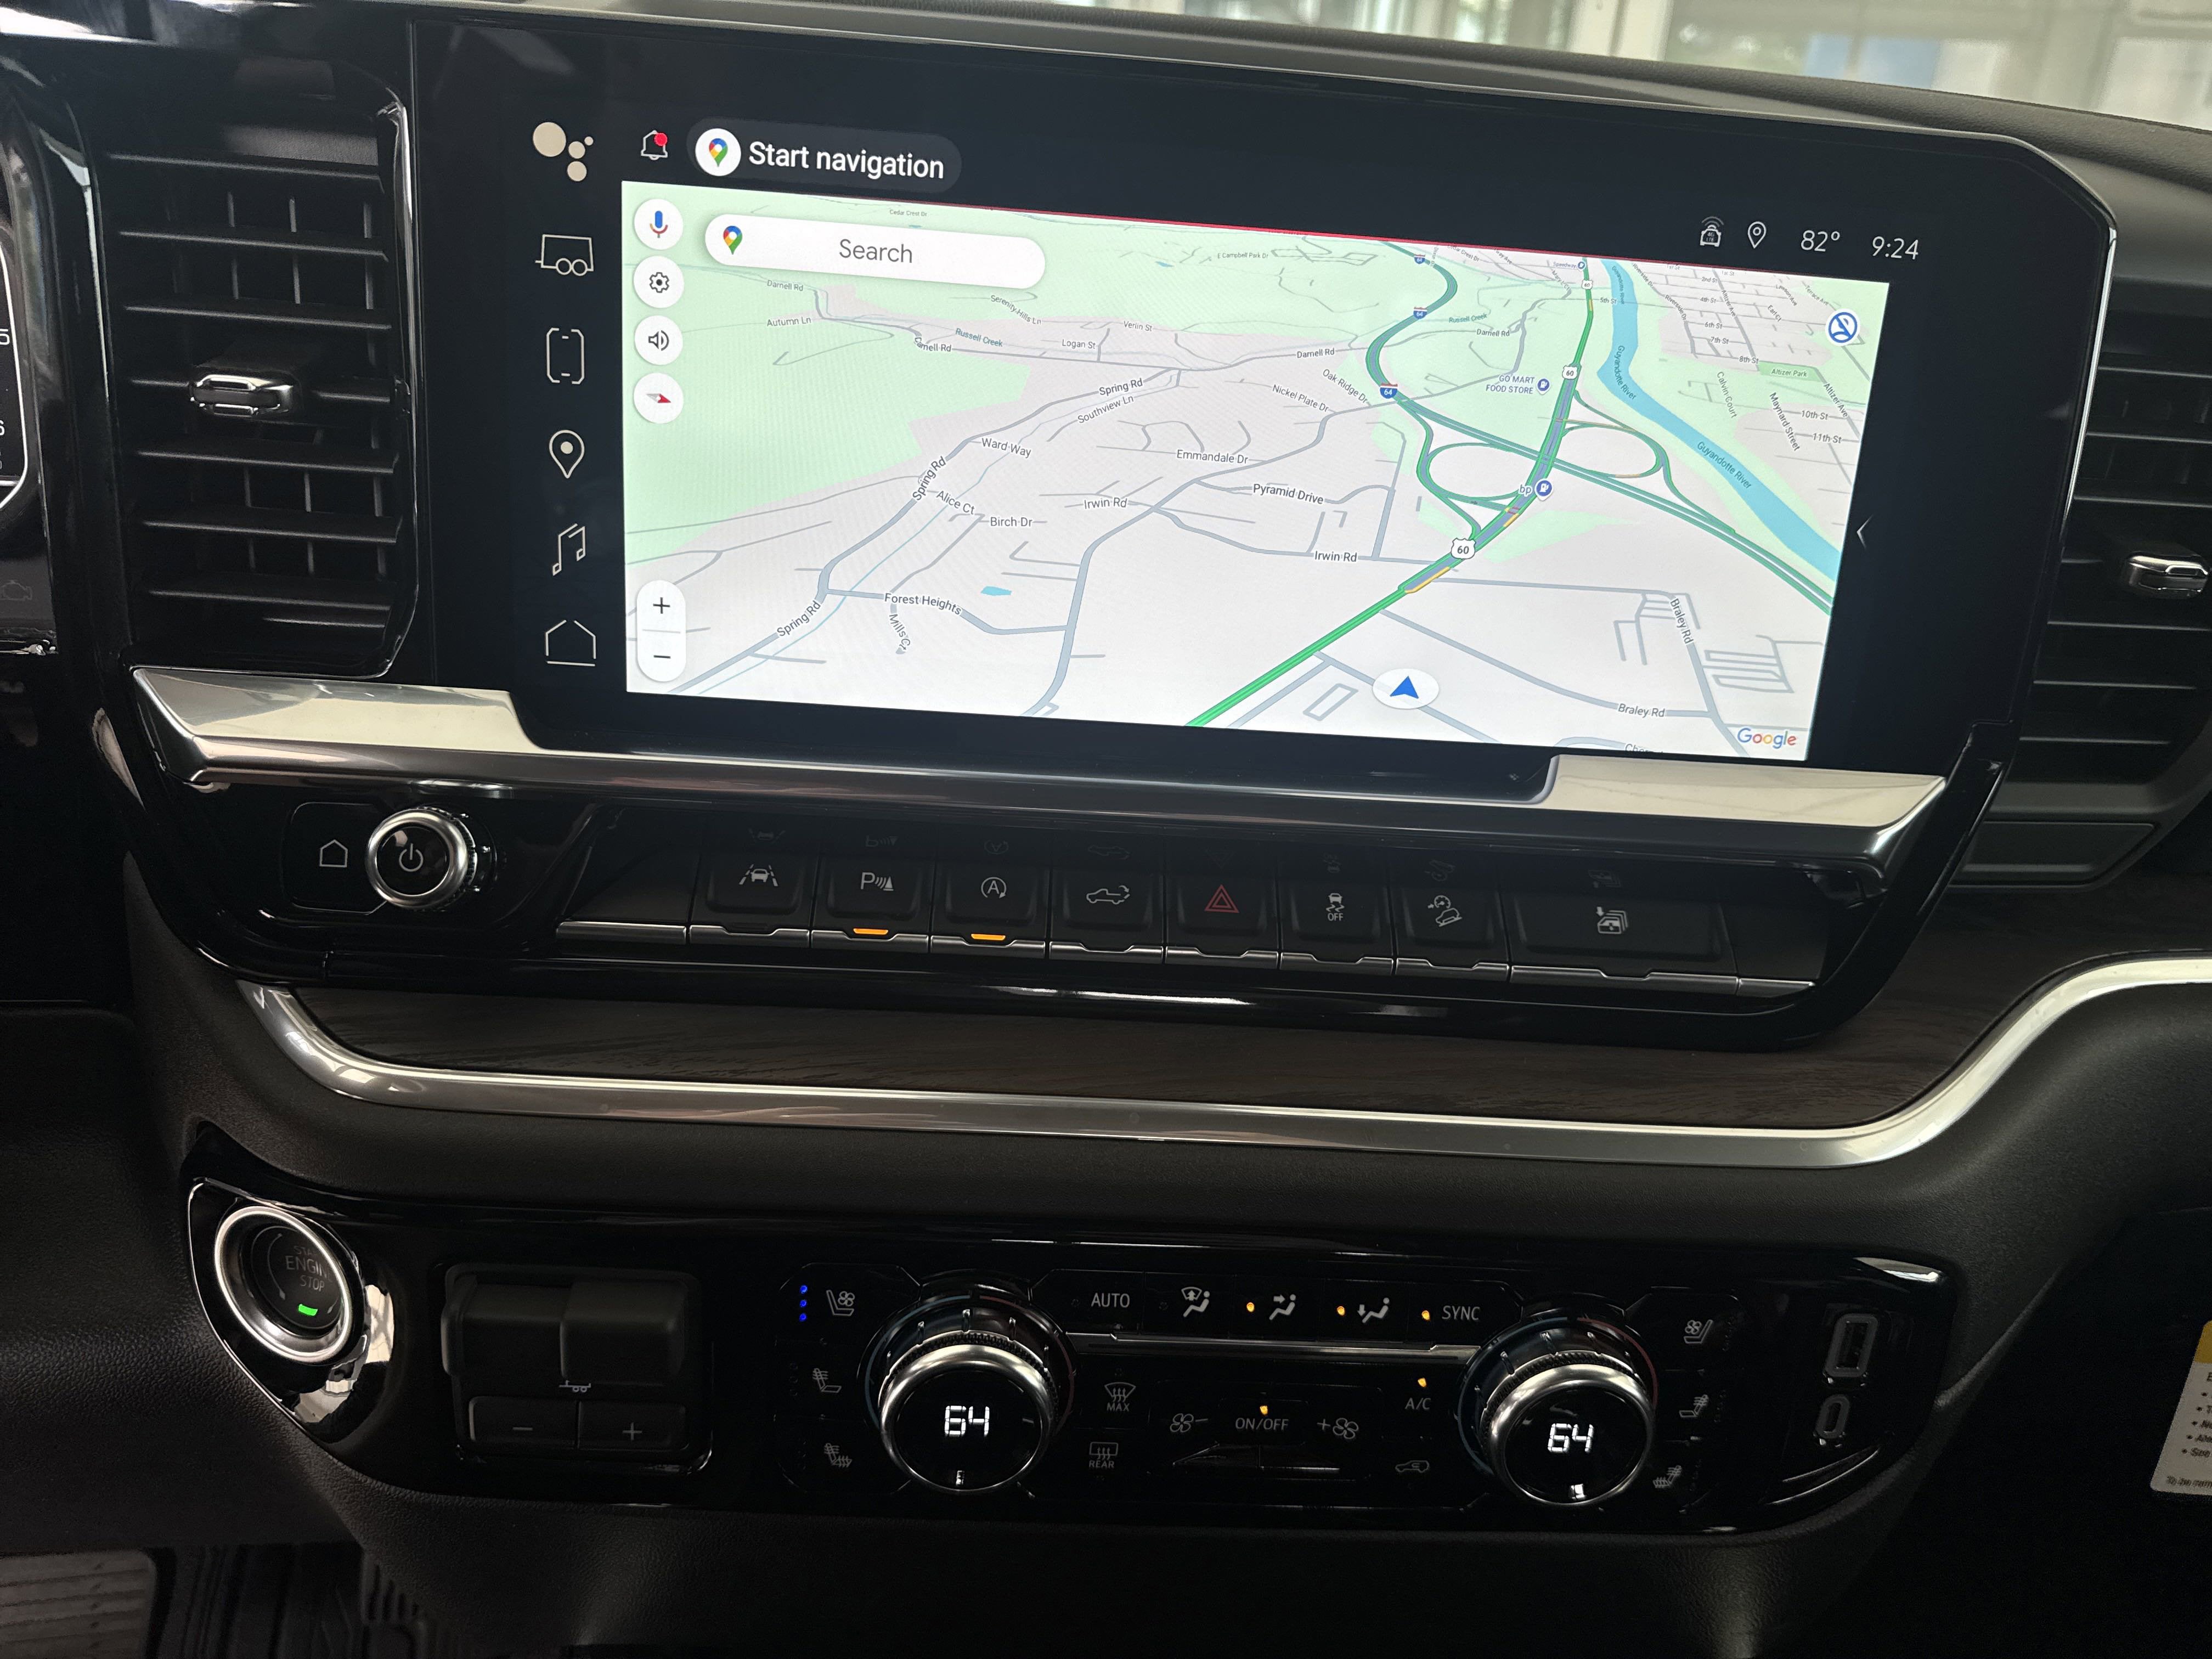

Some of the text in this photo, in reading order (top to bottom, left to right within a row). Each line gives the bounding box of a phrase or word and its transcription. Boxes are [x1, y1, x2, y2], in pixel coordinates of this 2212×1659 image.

[749, 141, 944, 179] Start navigation
[1801, 230, 1840, 252] 82°
[1871, 236, 1919, 260] 9:24
[839, 239, 912, 263] Search
[767, 279, 792, 290] Darnell
[991, 295, 1017, 313] Serenity
[1018, 309, 1031, 324] Hills
[1664, 295, 1684, 314] Riverside
[1768, 305, 1777, 317] Earl
[767, 318, 799, 326] Autumn
[1123, 320, 1143, 330] Verlin
[1471, 313, 1488, 321] Creek
[956, 328, 1003, 347] Russell Creek
[1476, 329, 1499, 337] Darnell
[941, 344, 952, 352] Rd
[1062, 339, 1096, 349] Logan St
[1296, 348, 1323, 359] Darnell
[1615, 345, 1637, 400] Guyandotte River
[1099, 377, 1143, 396] Spring Rd
[1322, 369, 1368, 404] Oak Ridge Dr
[1486, 385, 1534, 394] FOOD STORE
[1717, 371, 1738, 418] Calvin Court
[1272, 384, 1330, 413] Nickel Plate Dr
[1824, 383, 1848, 418] Altizer Ave
[1077, 395, 1135, 424] Southview Ln
[1802, 410, 1829, 420] 10th St
[1769, 392, 1801, 452] Maynard Street
[1813, 433, 1842, 444] 11th St
[981, 437, 1031, 459] Ward Way
[1176, 449, 1249, 464] Emmandale Dr
[1697, 441, 1752, 489] Guyandotte River
[912, 455, 947, 501] Spring Rd
[1253, 483, 1324, 505] Pyramid Drive
[1520, 484, 1532, 495] bp
[935, 490, 975, 516] Alice Ct
[1084, 497, 1127, 510] Irwin Rd
[990, 516, 1033, 527] Birch Dr
[1314, 550, 1358, 563] Irwin Rd
[1457, 545, 1469, 555] 60
[884, 592, 962, 616] Forest Heights
[776, 600, 822, 637] Spring Rd
[1670, 597, 1694, 645] Braley Rd
[889, 613, 911, 651] Mills Ct
[1618, 703, 1665, 719] Braley Rd
[1737, 727, 1797, 749] Google
[1327, 912, 1344, 922] OFF
[300, 1274, 325, 1292] STOP
[1091, 1292, 1131, 1308] AUTO
[1441, 1305, 1481, 1321] SYNC
[1107, 1402, 1130, 1412] MAX
[1404, 1397, 1431, 1410] A/C
[944, 1405, 990, 1437] 64
[1235, 1418, 1289, 1431] ON/OFF
[1548, 1423, 1594, 1454] 64
[1088, 1459, 1115, 1469] REAR
